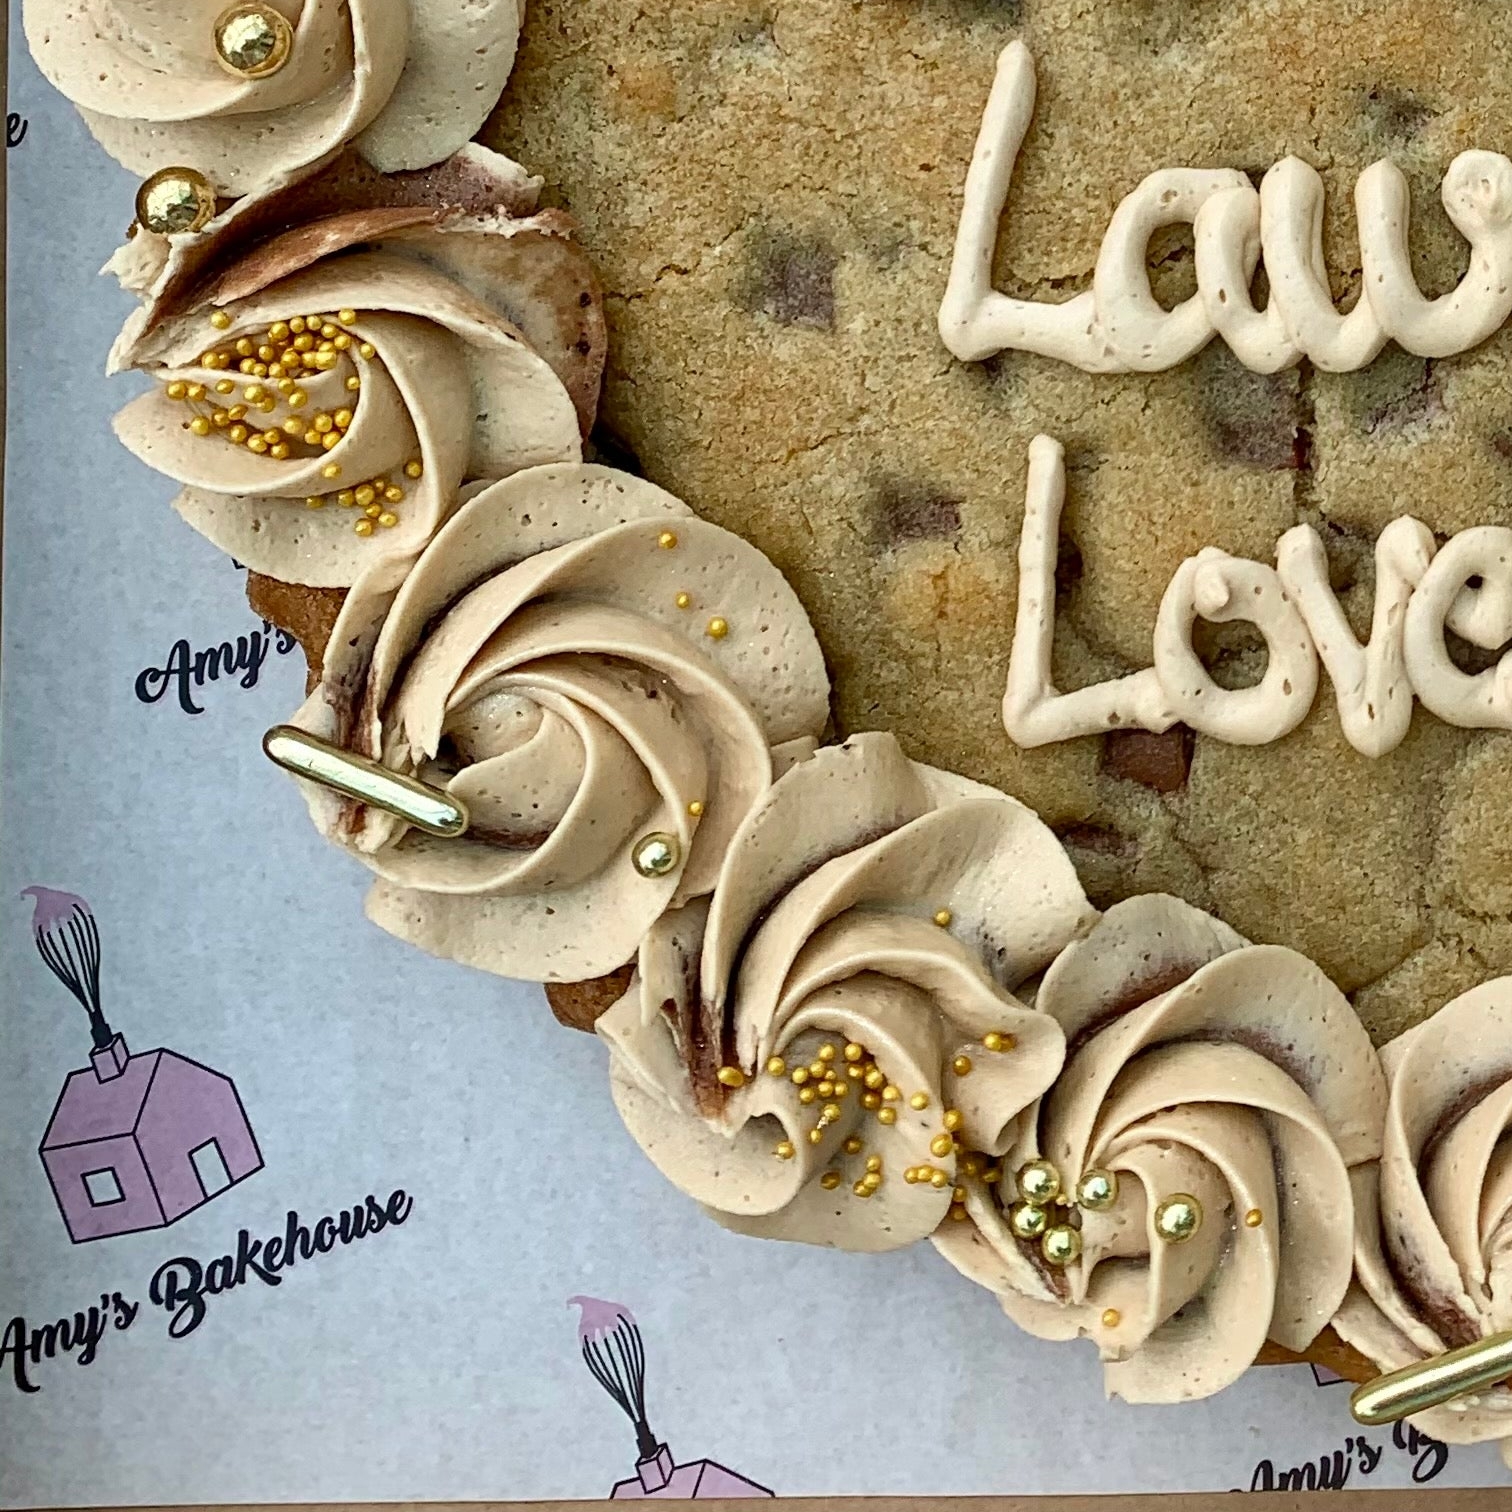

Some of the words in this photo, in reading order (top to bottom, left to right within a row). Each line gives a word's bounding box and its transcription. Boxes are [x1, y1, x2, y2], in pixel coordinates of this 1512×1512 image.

[135, 621, 297, 714] Amy's
[0, 1293, 138, 1393] Amy's
[149, 1189, 414, 1338] Bakehouse
